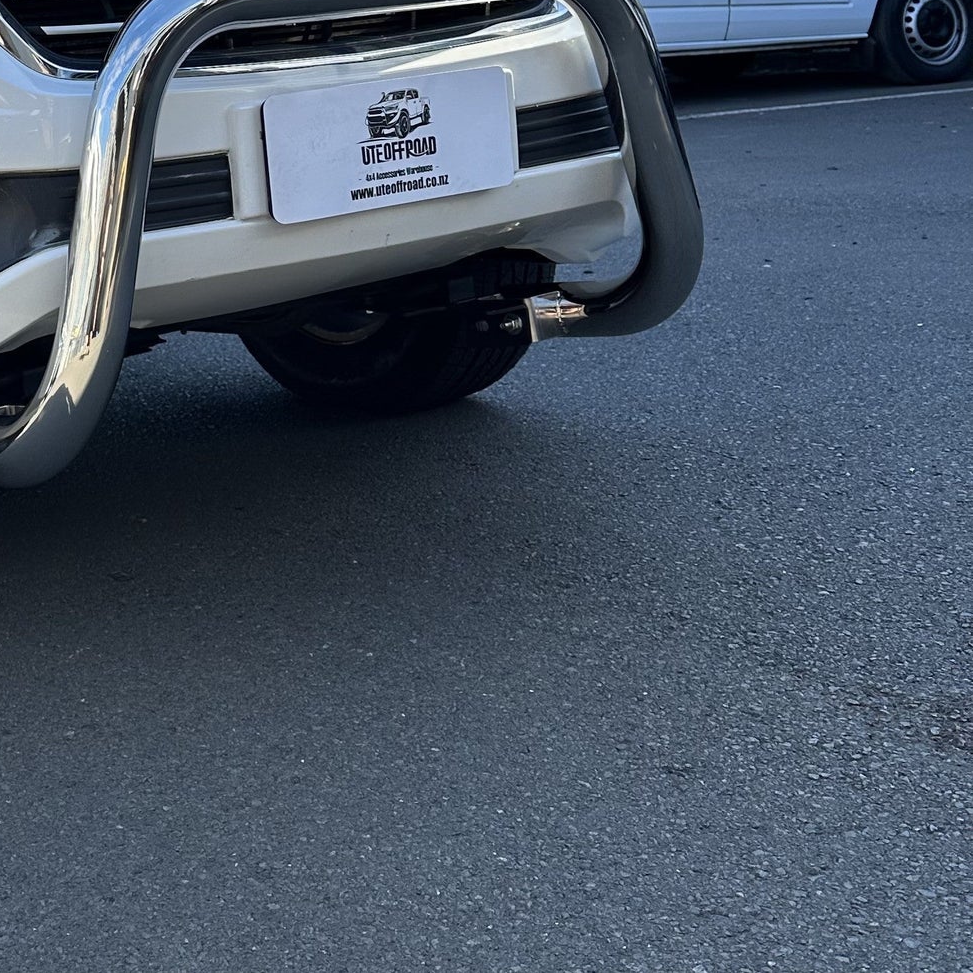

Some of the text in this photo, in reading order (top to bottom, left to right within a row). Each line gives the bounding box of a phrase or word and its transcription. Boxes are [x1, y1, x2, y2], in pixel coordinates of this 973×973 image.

[361, 136, 437, 165] UTEOFFROAD
[365, 164, 433, 182] 4x4 Accessories Warehouse
[350, 174, 449, 201] www.uteoffroad.co.nz
